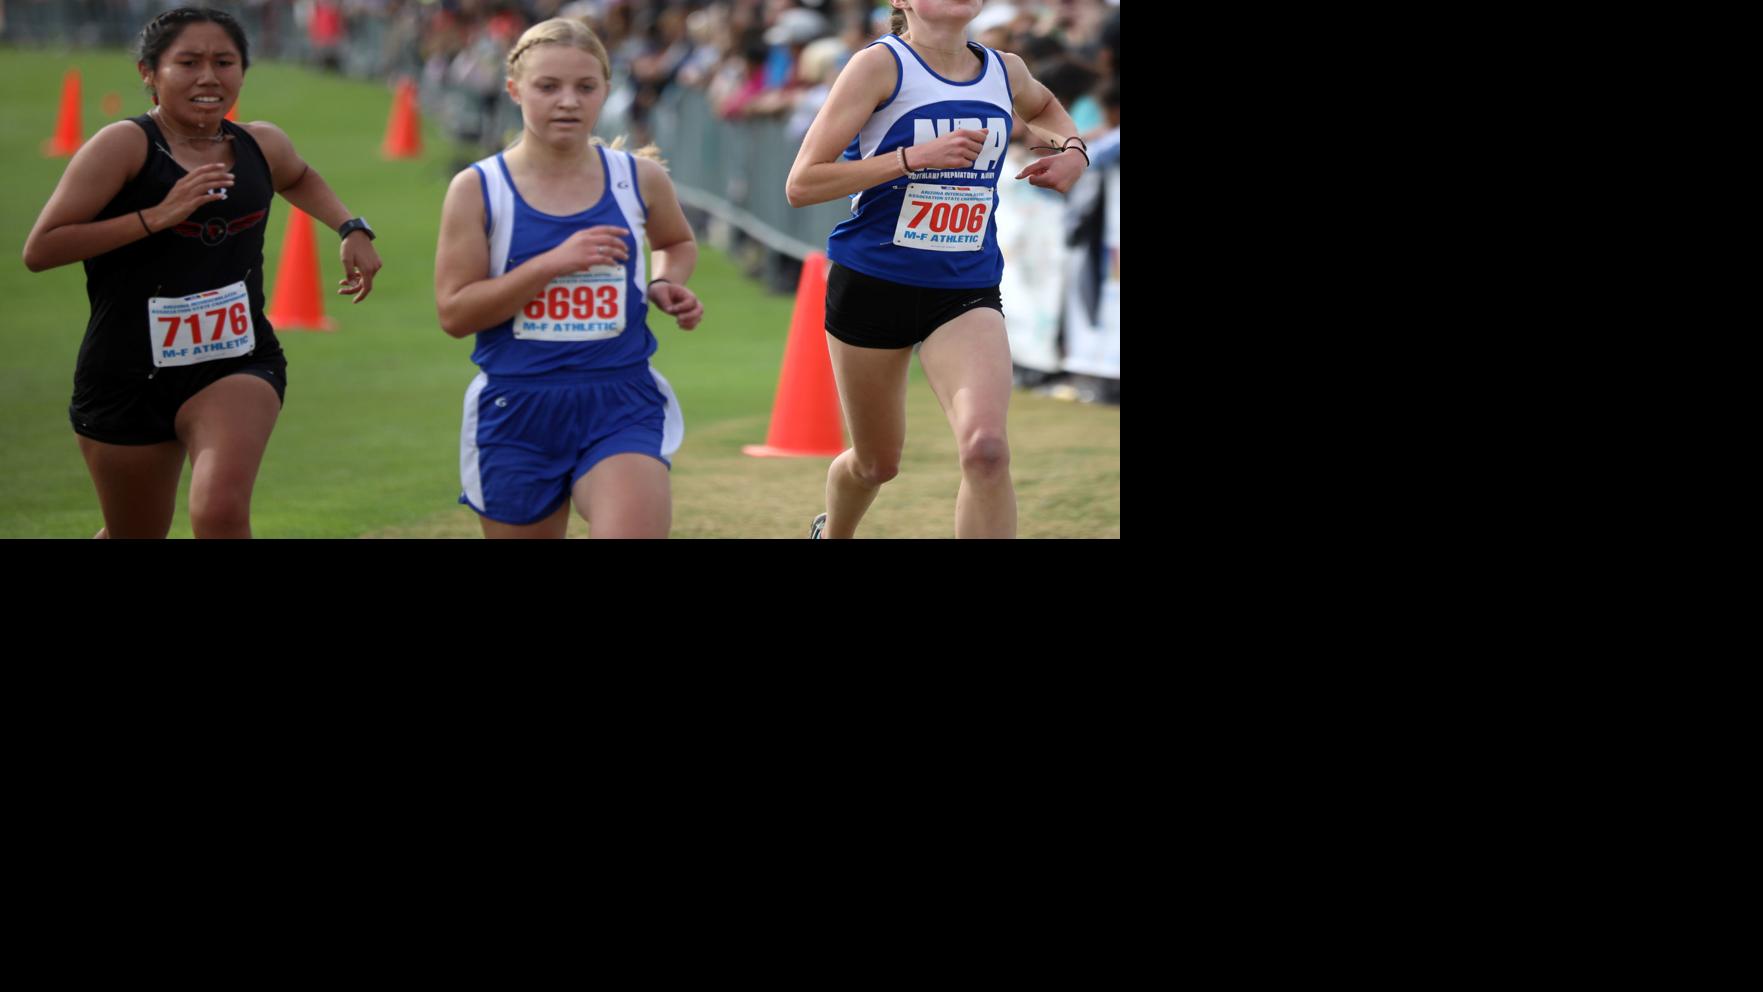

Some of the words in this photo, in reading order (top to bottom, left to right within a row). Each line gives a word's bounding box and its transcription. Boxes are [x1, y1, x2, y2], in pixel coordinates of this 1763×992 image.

[907, 200, 987, 233] 7006
[903, 230, 929, 241] M-F
[930, 234, 979, 244] ATHLETIC
[522, 285, 619, 321] 6693
[157, 302, 249, 349] 7176
[522, 321, 549, 332] M-F
[553, 321, 618, 333] ATHLETIC
[162, 348, 189, 359] M-F
[192, 335, 249, 355] ATHLETIC
